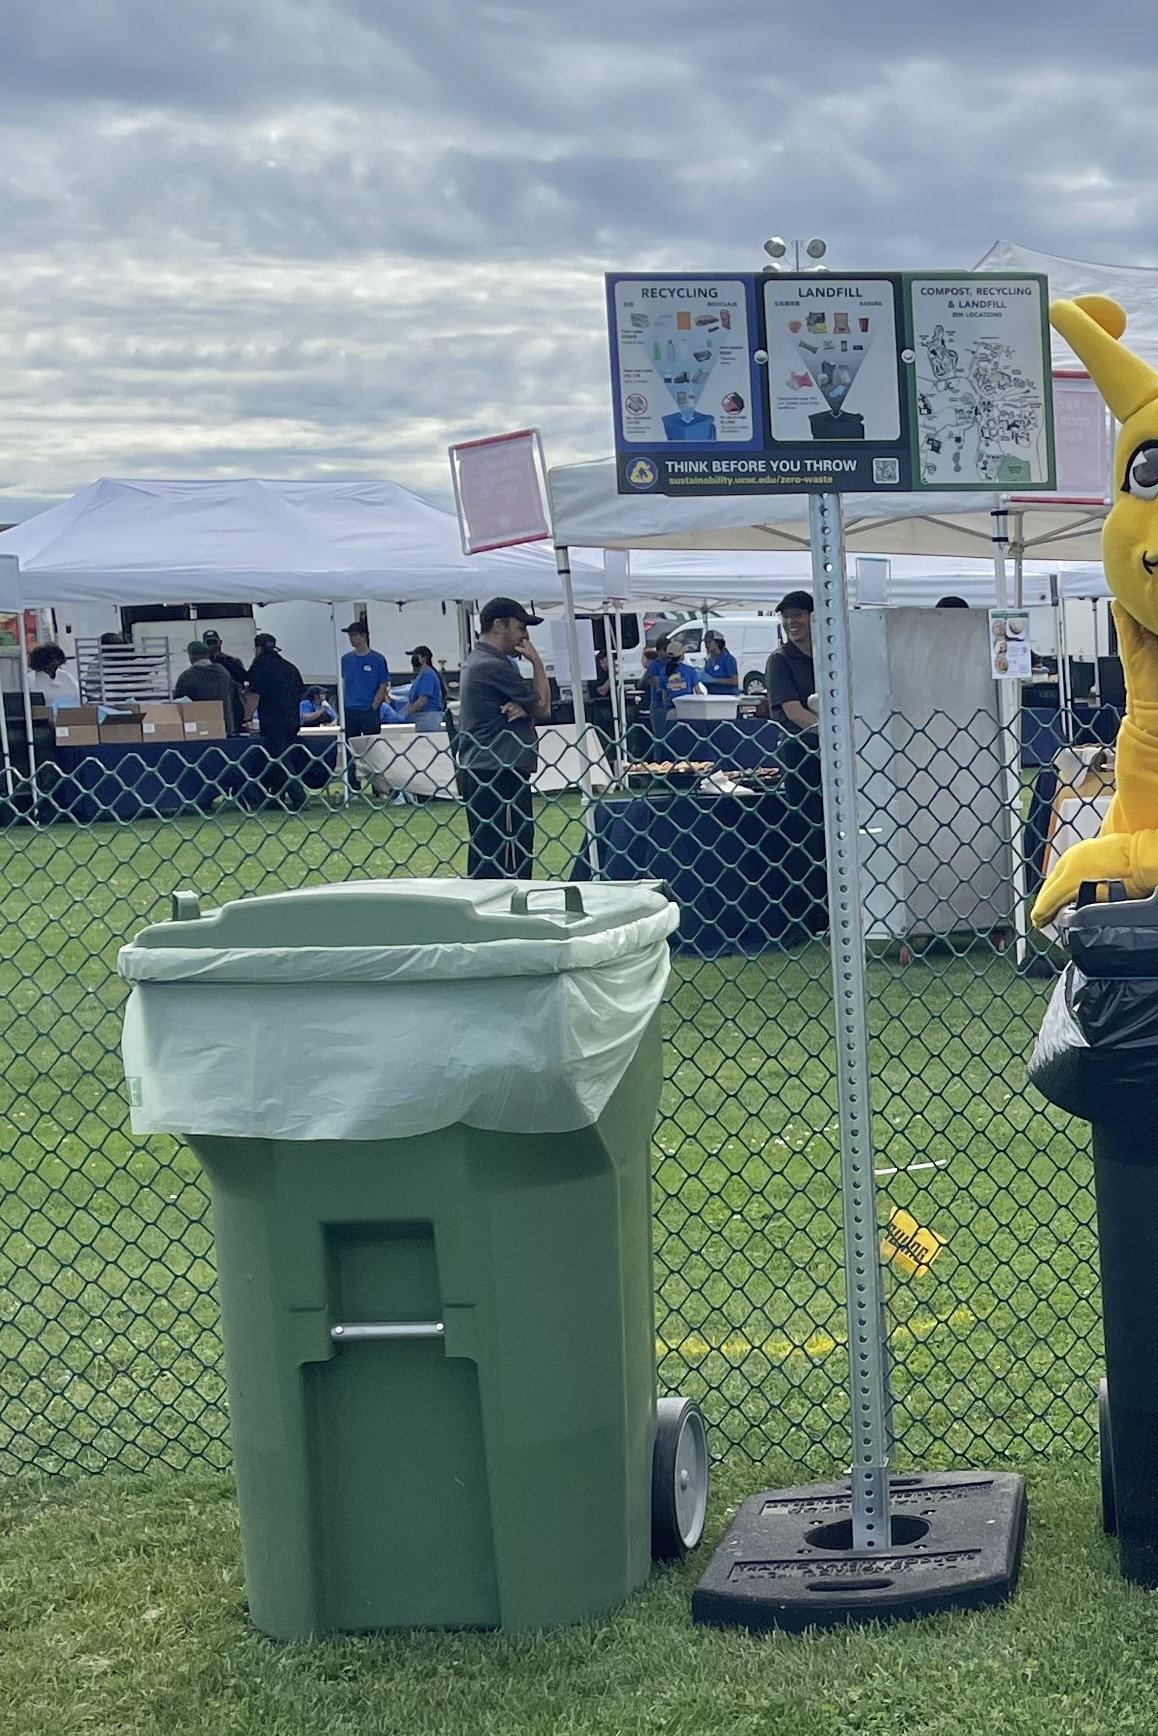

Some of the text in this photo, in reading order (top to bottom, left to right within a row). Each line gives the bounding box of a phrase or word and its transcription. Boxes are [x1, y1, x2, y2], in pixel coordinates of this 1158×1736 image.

[641, 288, 718, 299] RECYCLING
[798, 287, 863, 298] LANDFILL
[920, 287, 1032, 297] COMPOST, RECYCLING
[948, 300, 1007, 309] & LANDFILL
[665, 459, 858, 473] THINK BEFORE YOU THROW
[668, 475, 833, 486] sustainability.ucsc.edu/zero-waste
